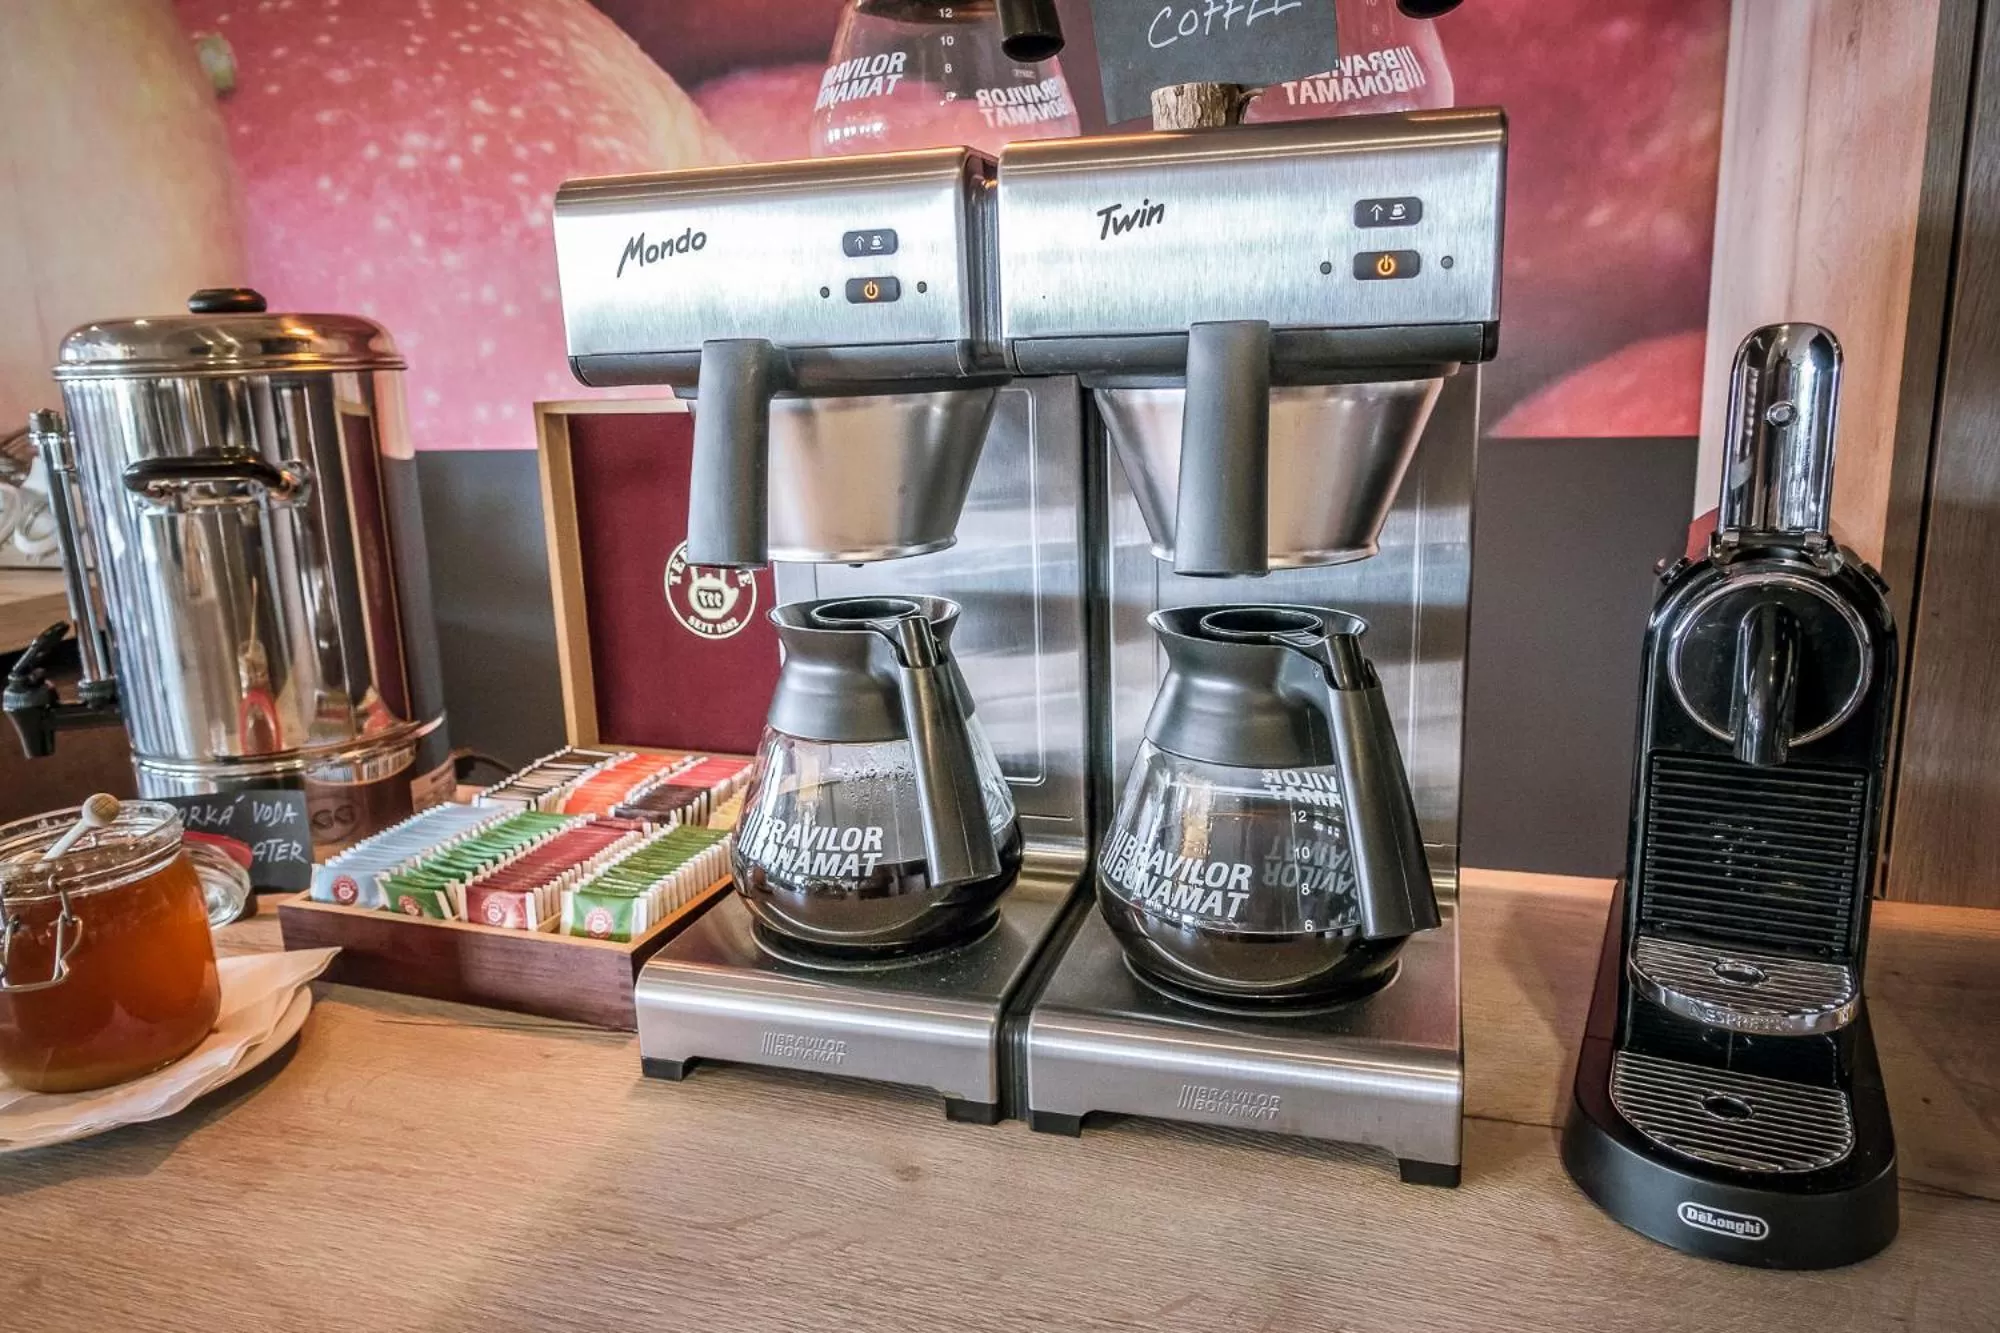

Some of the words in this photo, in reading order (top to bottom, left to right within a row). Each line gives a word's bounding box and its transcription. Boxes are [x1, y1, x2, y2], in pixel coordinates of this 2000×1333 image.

[939, 8, 953, 18] 12
[941, 36, 954, 46] 10
[944, 63, 952, 73] 8
[1097, 199, 1165, 240] Twin
[617, 227, 707, 278] Mondo
[177, 794, 246, 827] ORKÁ
[252, 801, 299, 827] VODA
[1292, 810, 1307, 823] 12
[252, 838, 308, 864] ATER
[1294, 847, 1310, 859] 10
[1120, 834, 1253, 891] BRAVILOR
[1110, 857, 1250, 919] BONAMAT
[1301, 883, 1310, 895] 8
[1305, 921, 1313, 932] 6
[776, 1033, 847, 1053] BRAVILOR
[773, 1045, 846, 1065] BONAMAT
[1196, 1086, 1281, 1107] BRAVILOR
[1192, 1098, 1280, 1121] BONAMAT
